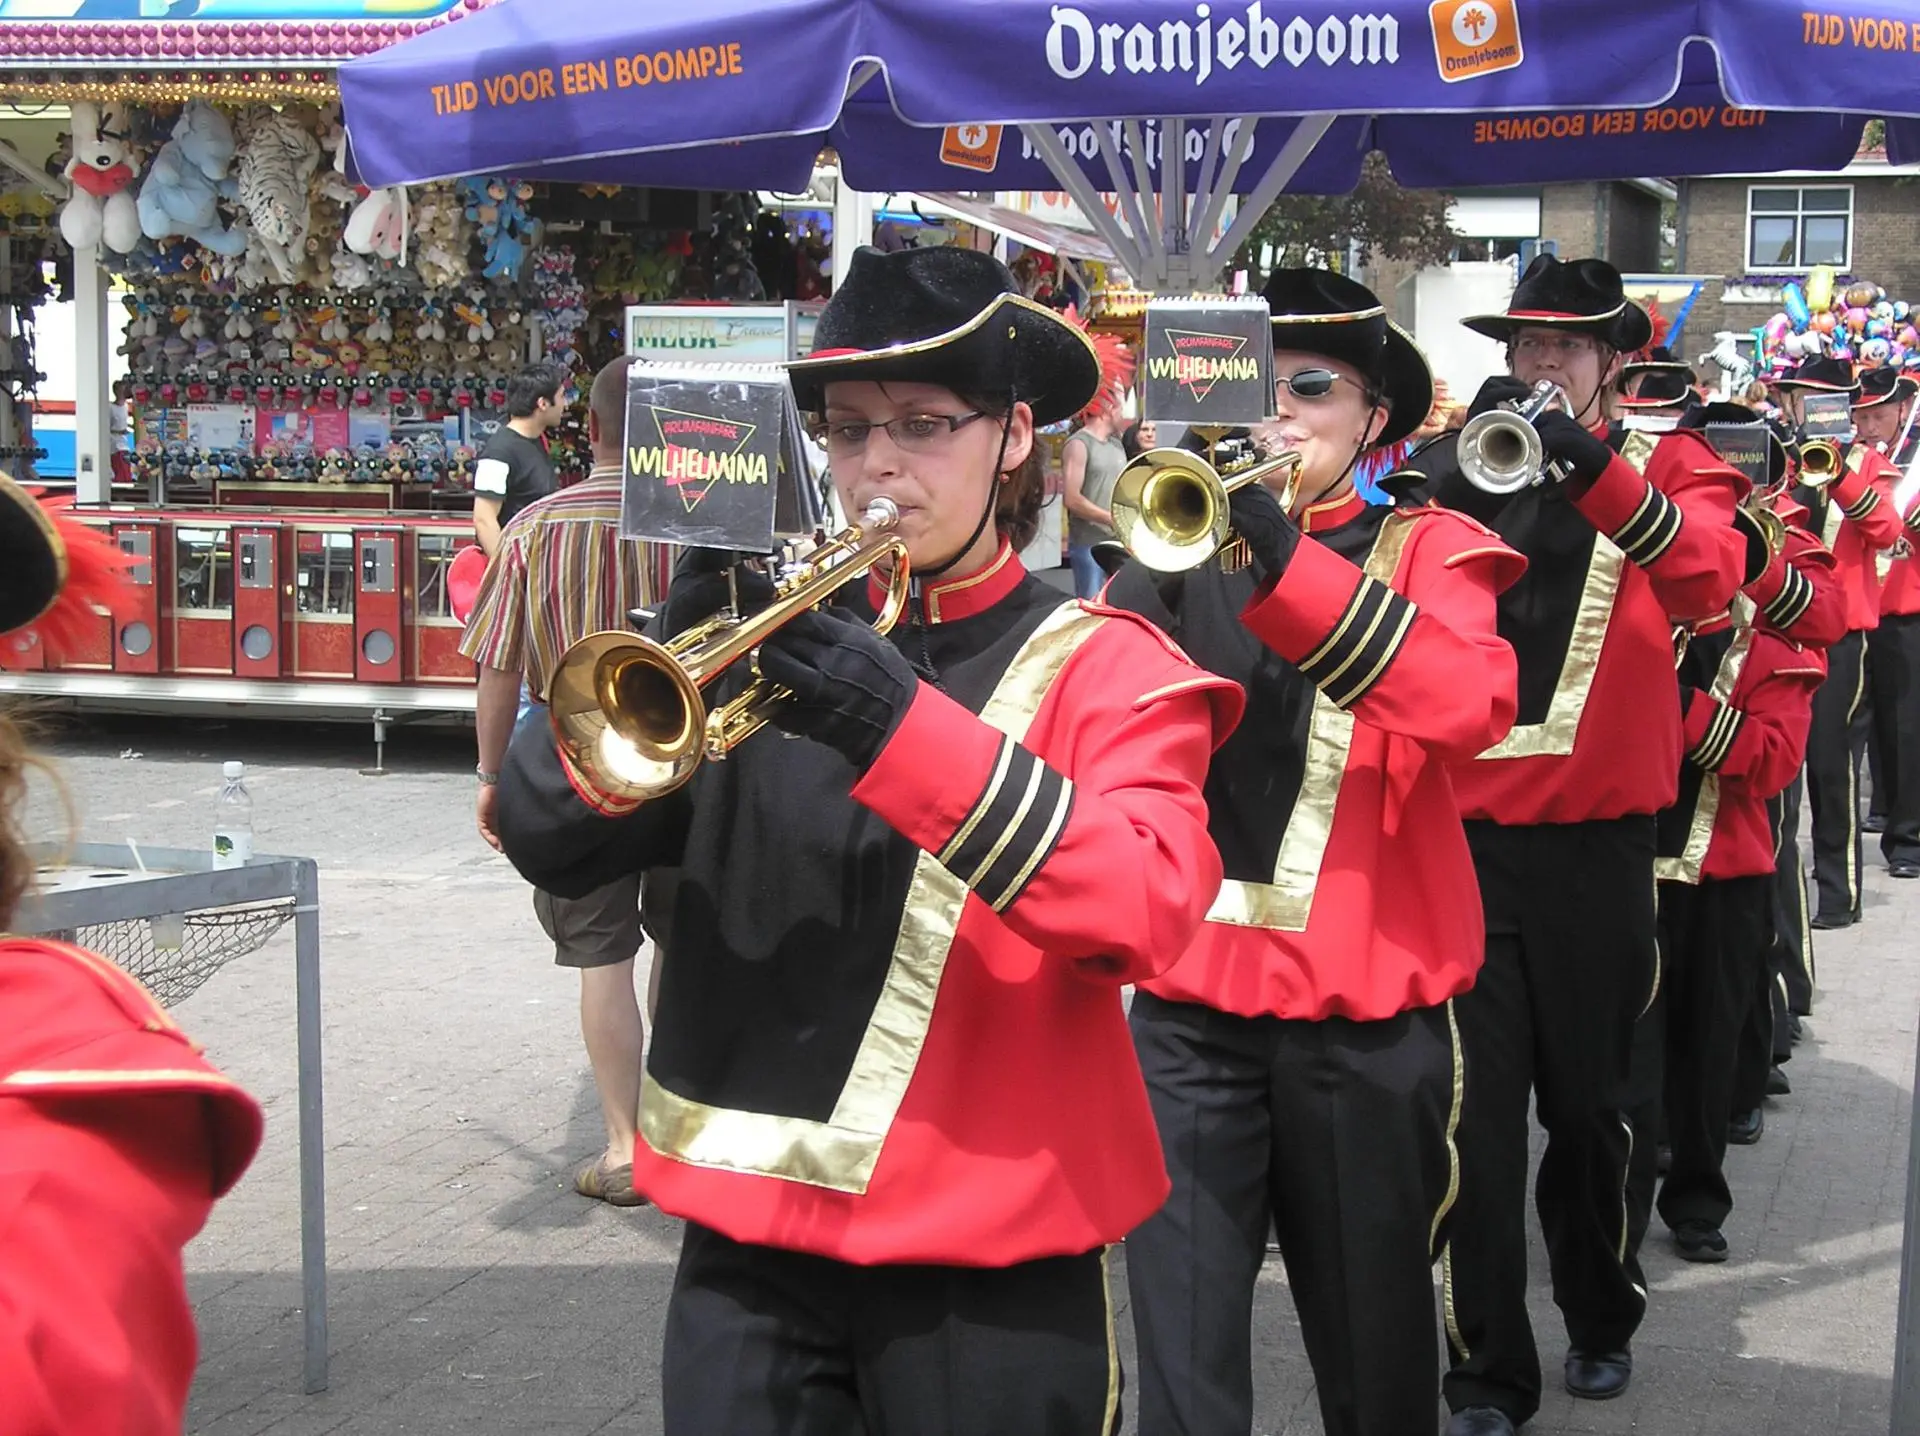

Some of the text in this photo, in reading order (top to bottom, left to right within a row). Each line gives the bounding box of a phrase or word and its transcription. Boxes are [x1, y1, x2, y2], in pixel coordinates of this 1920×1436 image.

[1045, 0, 1400, 86] Oranjeboom
[1802, 12, 1845, 46] TIJD
[1849, 16, 1907, 51] VOOR
[1446, 45, 1517, 72] Oranjeboom
[431, 43, 743, 116] TIJD VOOR EEN BOOMPJE
[1149, 356, 1258, 382] WILHELMINA
[629, 446, 768, 485] WILHELMINA
